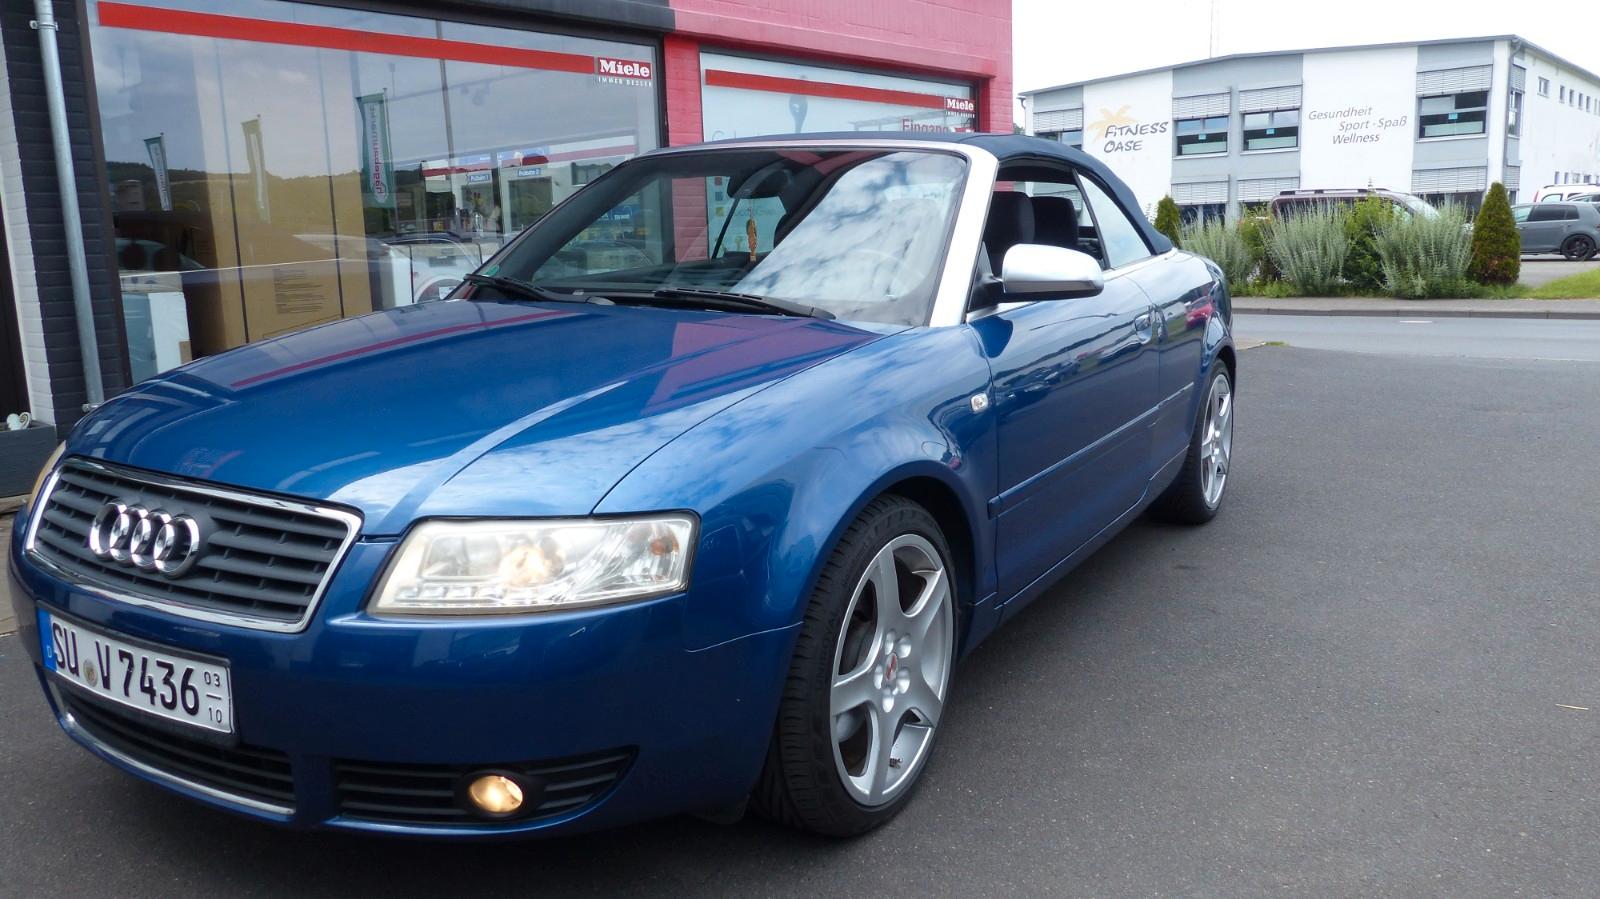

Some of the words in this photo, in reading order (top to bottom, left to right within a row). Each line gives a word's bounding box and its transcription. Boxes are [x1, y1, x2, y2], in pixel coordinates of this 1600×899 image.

[599, 59, 650, 77] Miele
[598, 76, 622, 84] IMMER
[946, 98, 974, 111] Miele
[1308, 107, 1373, 120] Gesundheit
[1339, 120, 1370, 133] Sport
[1377, 115, 1408, 130] Spaß
[1332, 132, 1380, 144] Wellness
[1104, 140, 1143, 153] OASE
[52, 622, 80, 678] SU
[118, 649, 200, 716] 7436
[203, 671, 221, 687] 03
[207, 706, 223, 724] 10
